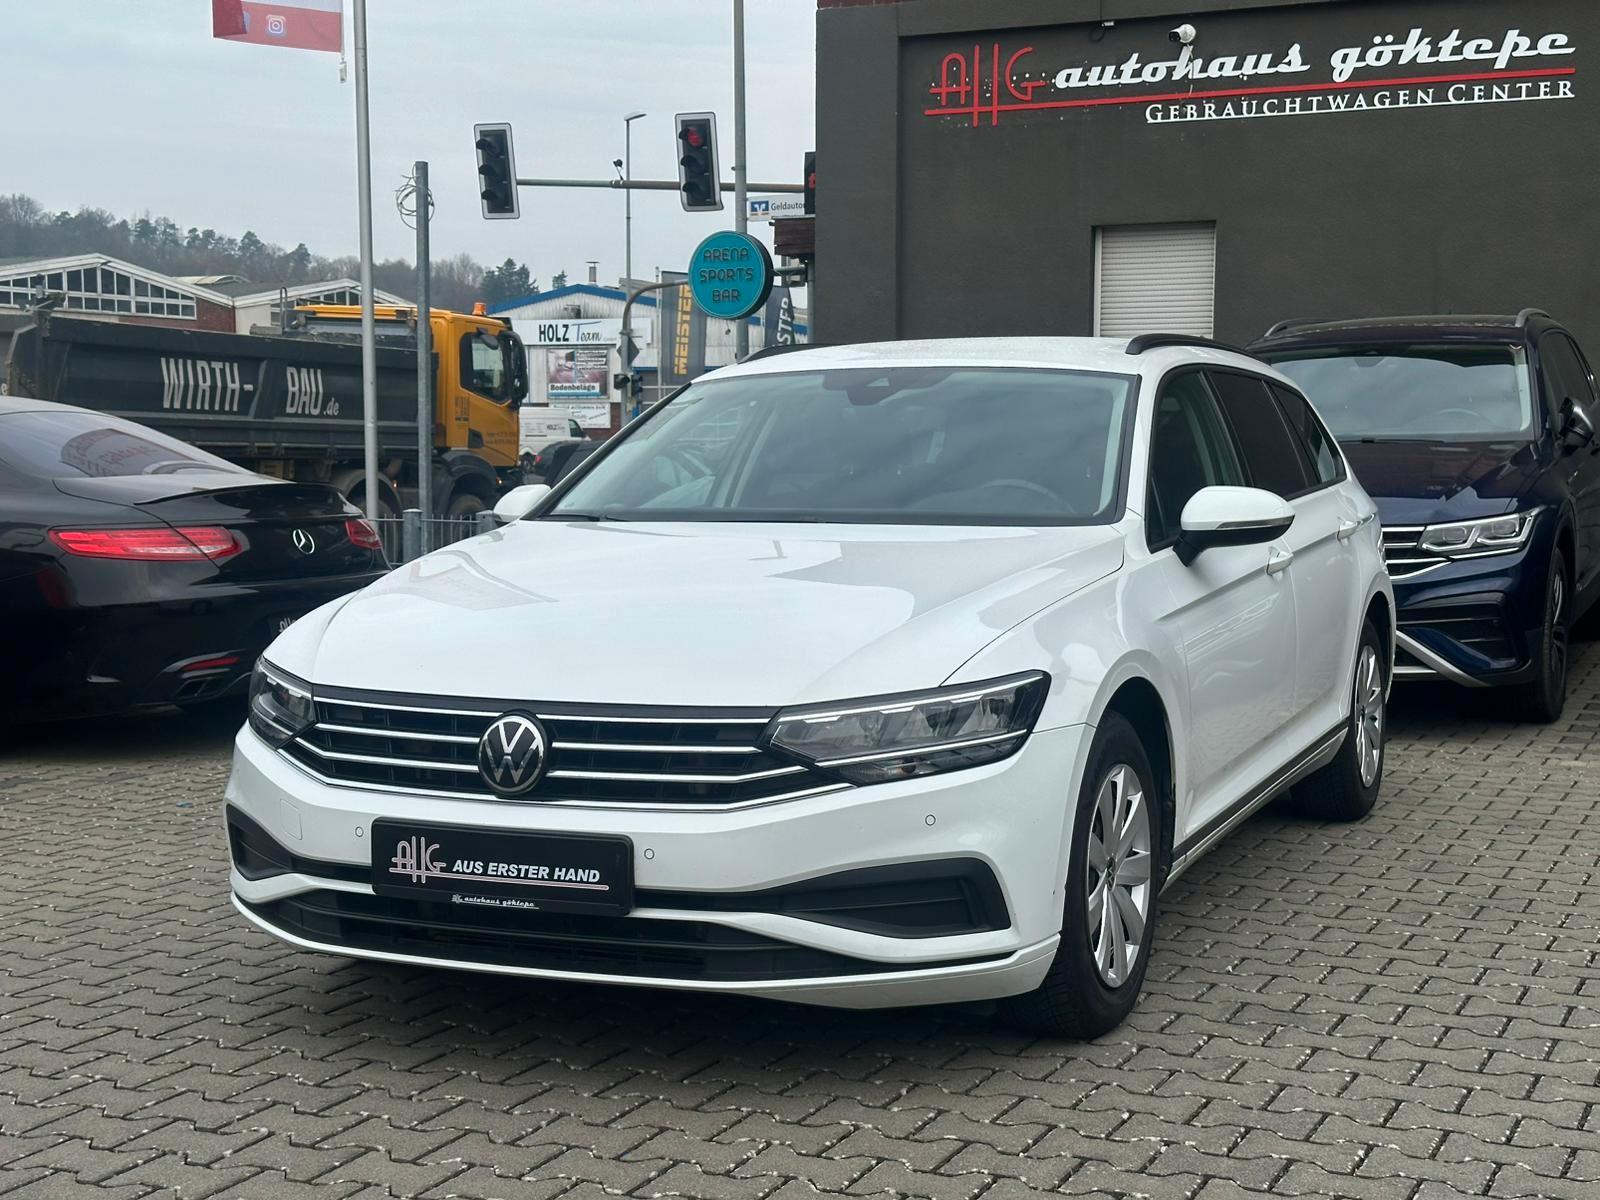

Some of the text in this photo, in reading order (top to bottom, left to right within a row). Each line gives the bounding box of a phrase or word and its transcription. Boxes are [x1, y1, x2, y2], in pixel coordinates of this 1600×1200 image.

[1055, 43, 1310, 88] autohaus
[1330, 28, 1576, 83] göktepe
[770, 201, 805, 211] Geldauto
[703, 247, 749, 263] ARENA
[700, 267, 753, 283] SPORTS
[711, 288, 741, 304] BAR
[538, 321, 601, 342] HOLZ Team
[160, 357, 254, 412] WIRTH-
[452, 860, 484, 874] AUS
[487, 862, 550, 880] ERSTER
[553, 867, 600, 883] HAND
